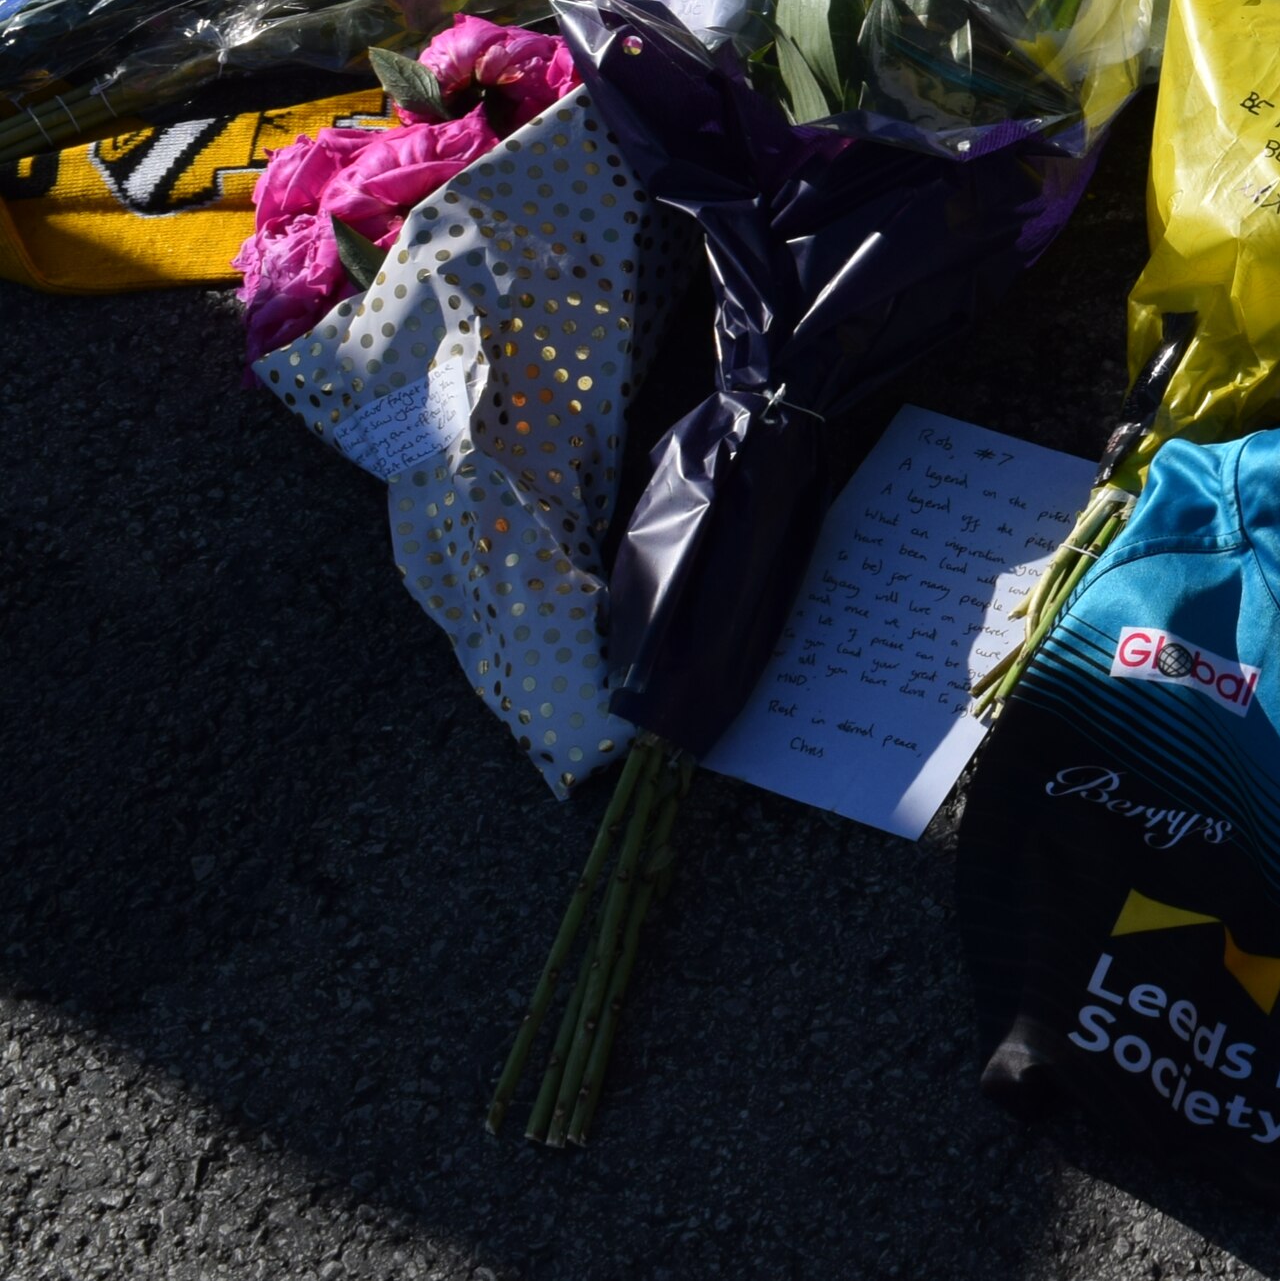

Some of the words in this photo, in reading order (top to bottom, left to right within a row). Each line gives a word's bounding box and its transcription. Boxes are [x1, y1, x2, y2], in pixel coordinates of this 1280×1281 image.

[1239, 90, 1276, 116] BE
[973, 447, 1015, 467] #7
[880, 482, 894, 496] A
[906, 488, 952, 515] legend
[898, 456, 914, 471] A
[925, 465, 969, 489] legend
[982, 488, 998, 500] on
[1036, 503, 1072, 526] pitch
[1118, 631, 1259, 708] Global
[767, 698, 799, 718] Rest
[788, 735, 826, 759] Chris
[1044, 765, 1234, 851] Berry's
[1086, 951, 1258, 1080] Leeds
